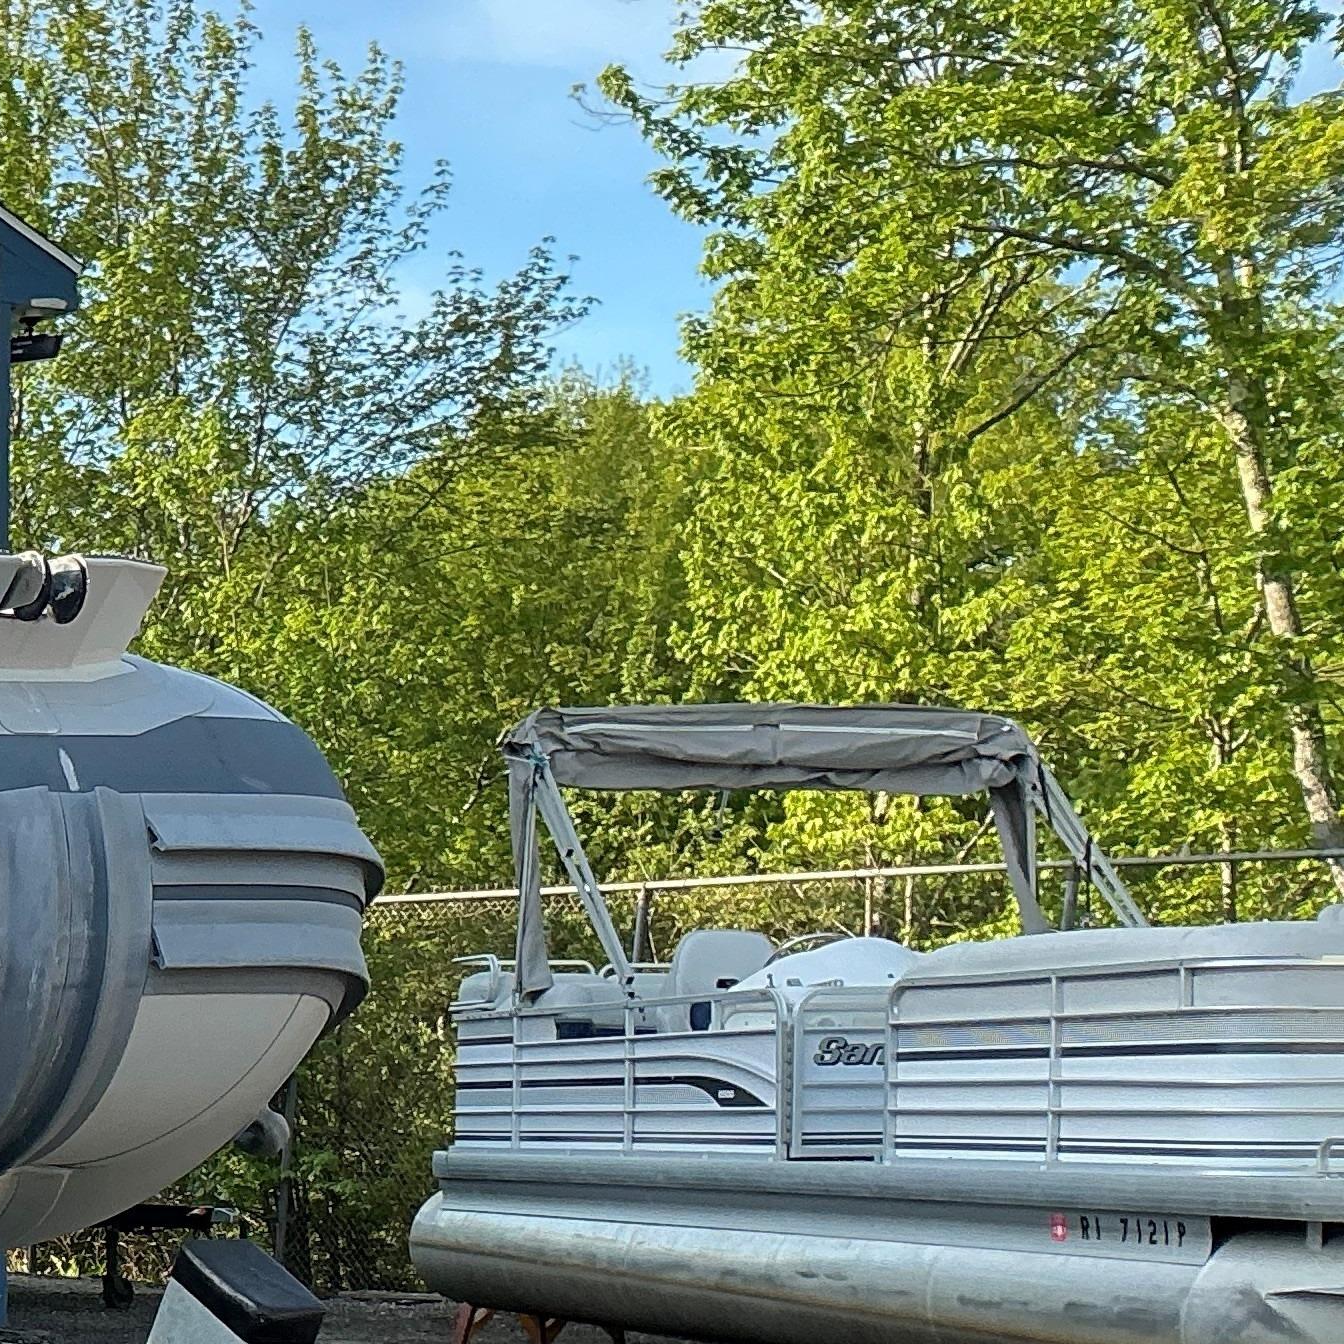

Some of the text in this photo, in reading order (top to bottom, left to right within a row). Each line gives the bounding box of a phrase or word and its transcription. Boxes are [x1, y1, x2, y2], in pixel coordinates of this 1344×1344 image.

[813, 1036, 886, 1066] San
[1079, 1215, 1187, 1248] RI 7121P
